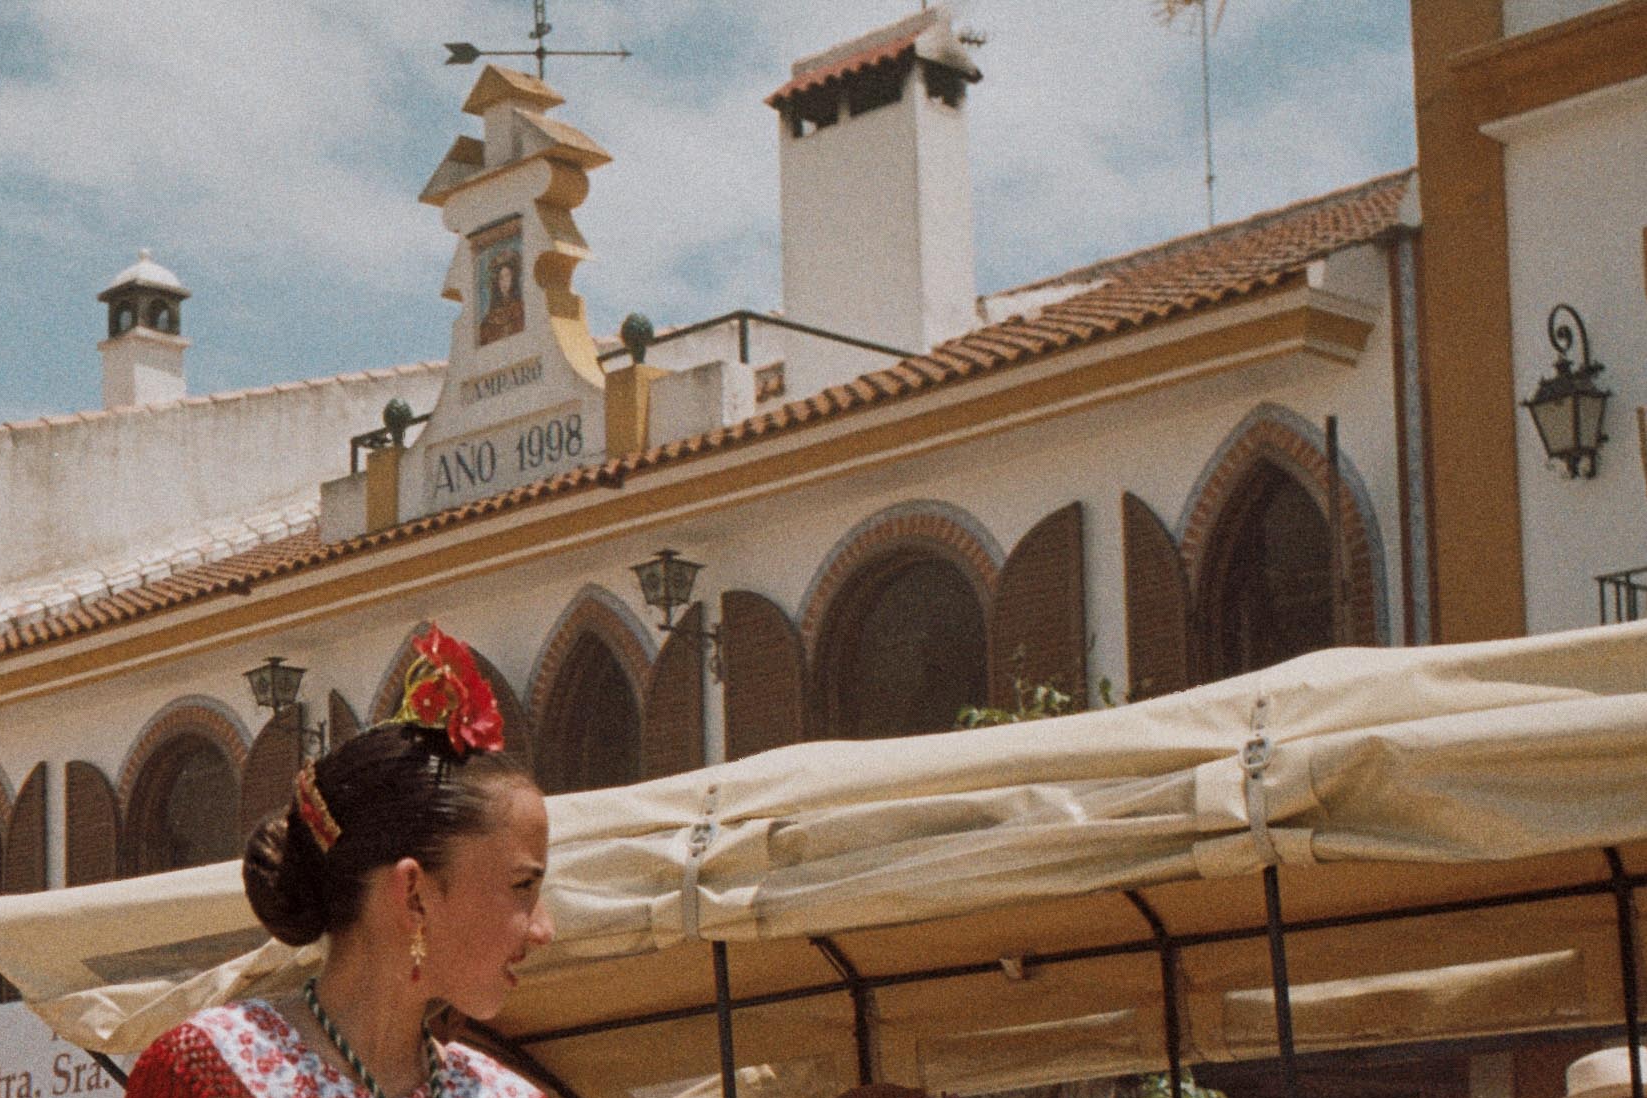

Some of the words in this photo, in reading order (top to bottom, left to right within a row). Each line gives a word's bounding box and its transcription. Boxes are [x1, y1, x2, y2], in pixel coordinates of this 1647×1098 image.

[434, 440, 496, 498] AÑO
[516, 414, 583, 472] 1998
[52, 1053, 111, 1096] Sra.
